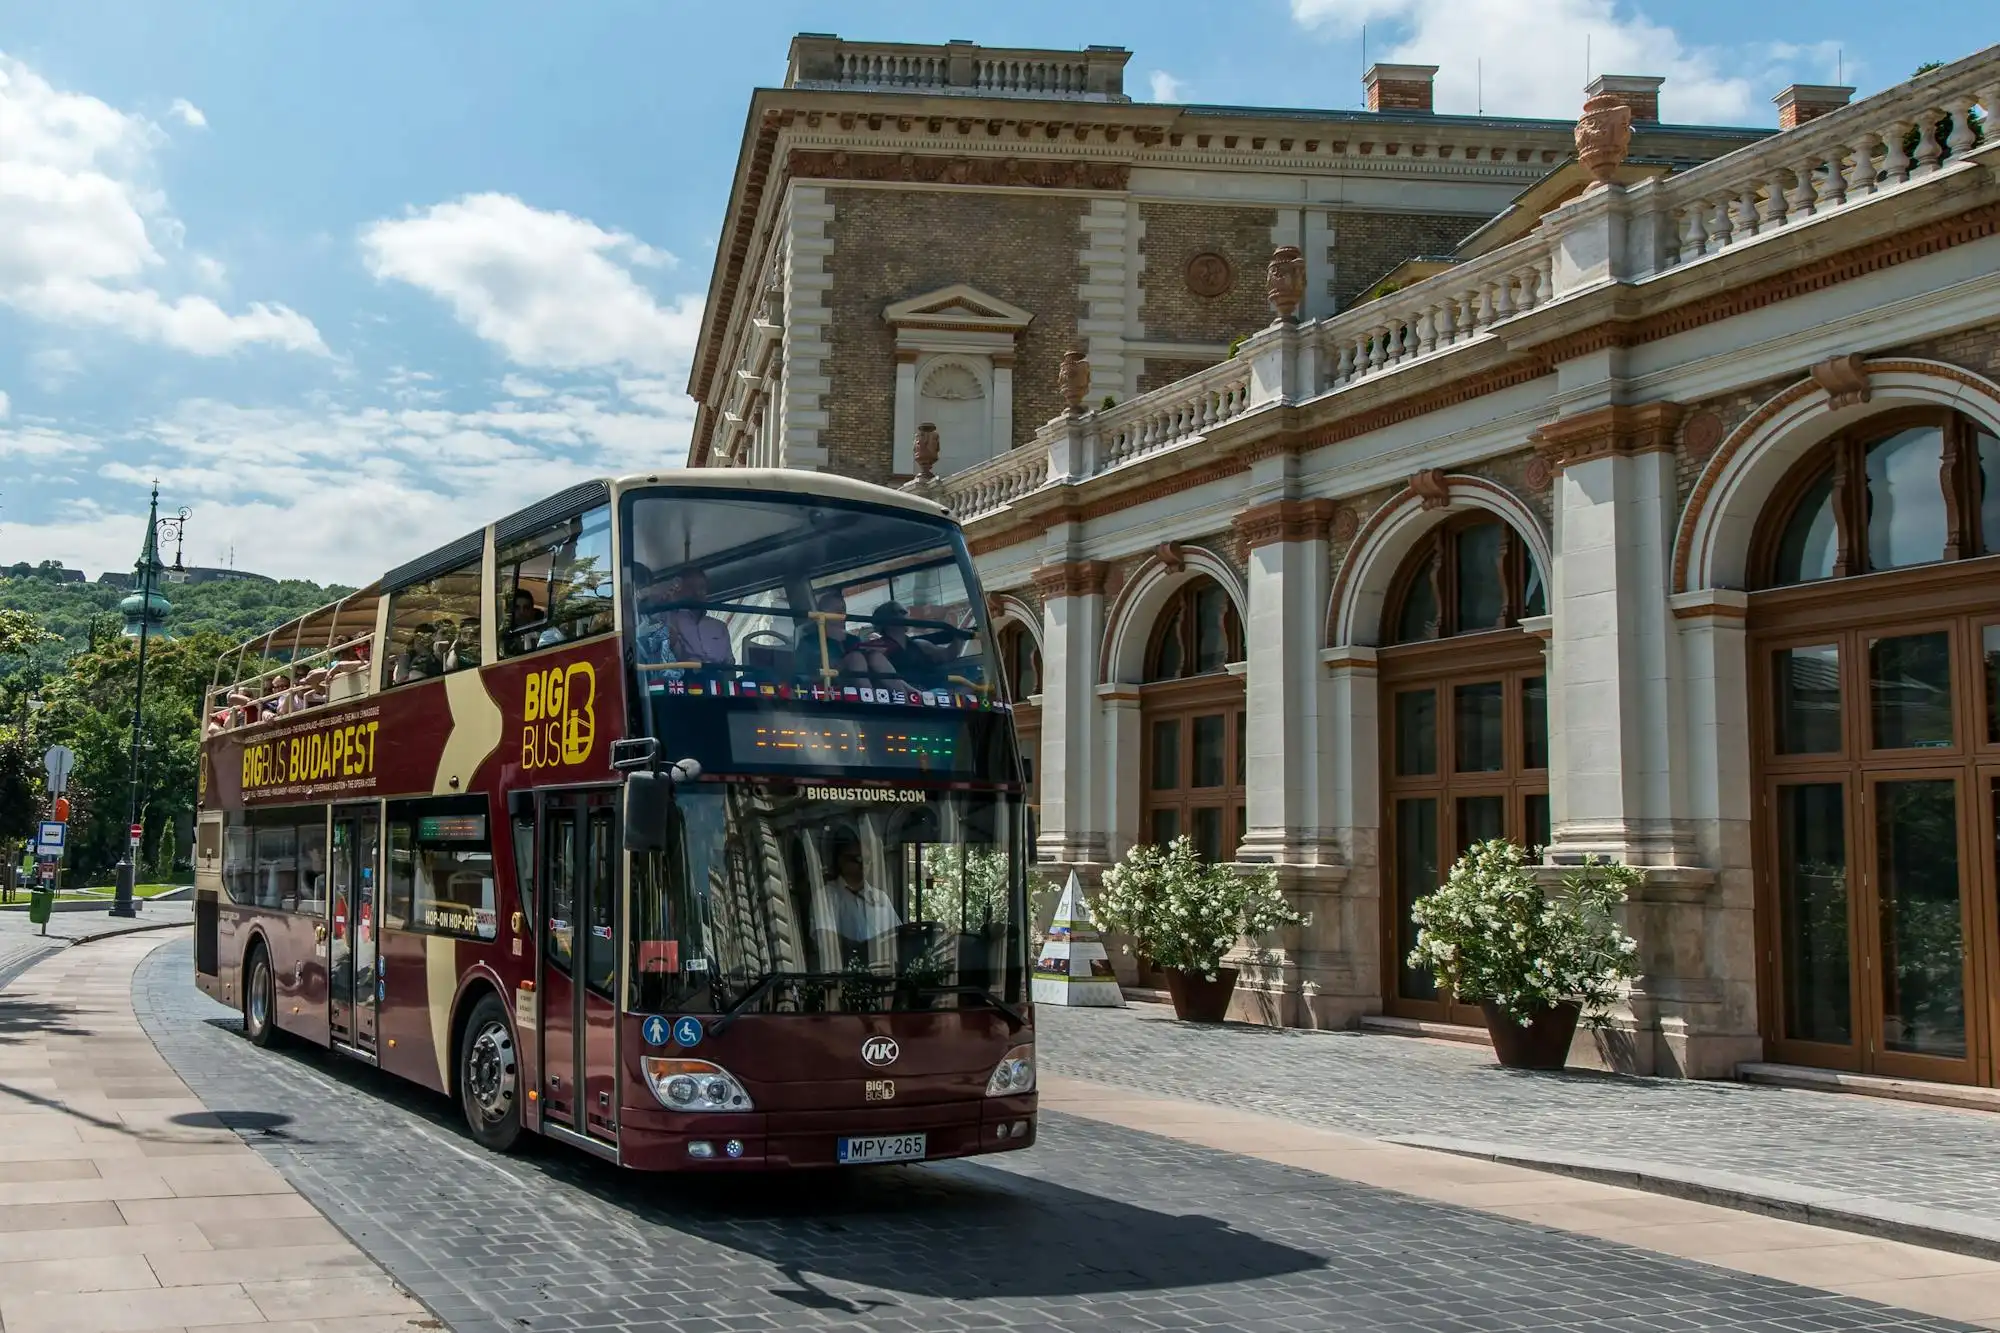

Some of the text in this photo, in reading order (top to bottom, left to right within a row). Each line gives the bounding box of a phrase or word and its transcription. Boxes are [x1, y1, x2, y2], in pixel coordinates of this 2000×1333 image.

[525, 667, 563, 721] BIG
[289, 721, 379, 782] BUDAPEST
[522, 721, 561, 769] BUS
[807, 787, 926, 803] BIGBUSTOURS.COM
[425, 909, 448, 928] HOP-ON
[449, 912, 477, 932] HOP-OFF
[865, 1080, 882, 1091] BIG
[865, 1091, 882, 1101] BUS
[851, 1137, 922, 1158] MPY-265
